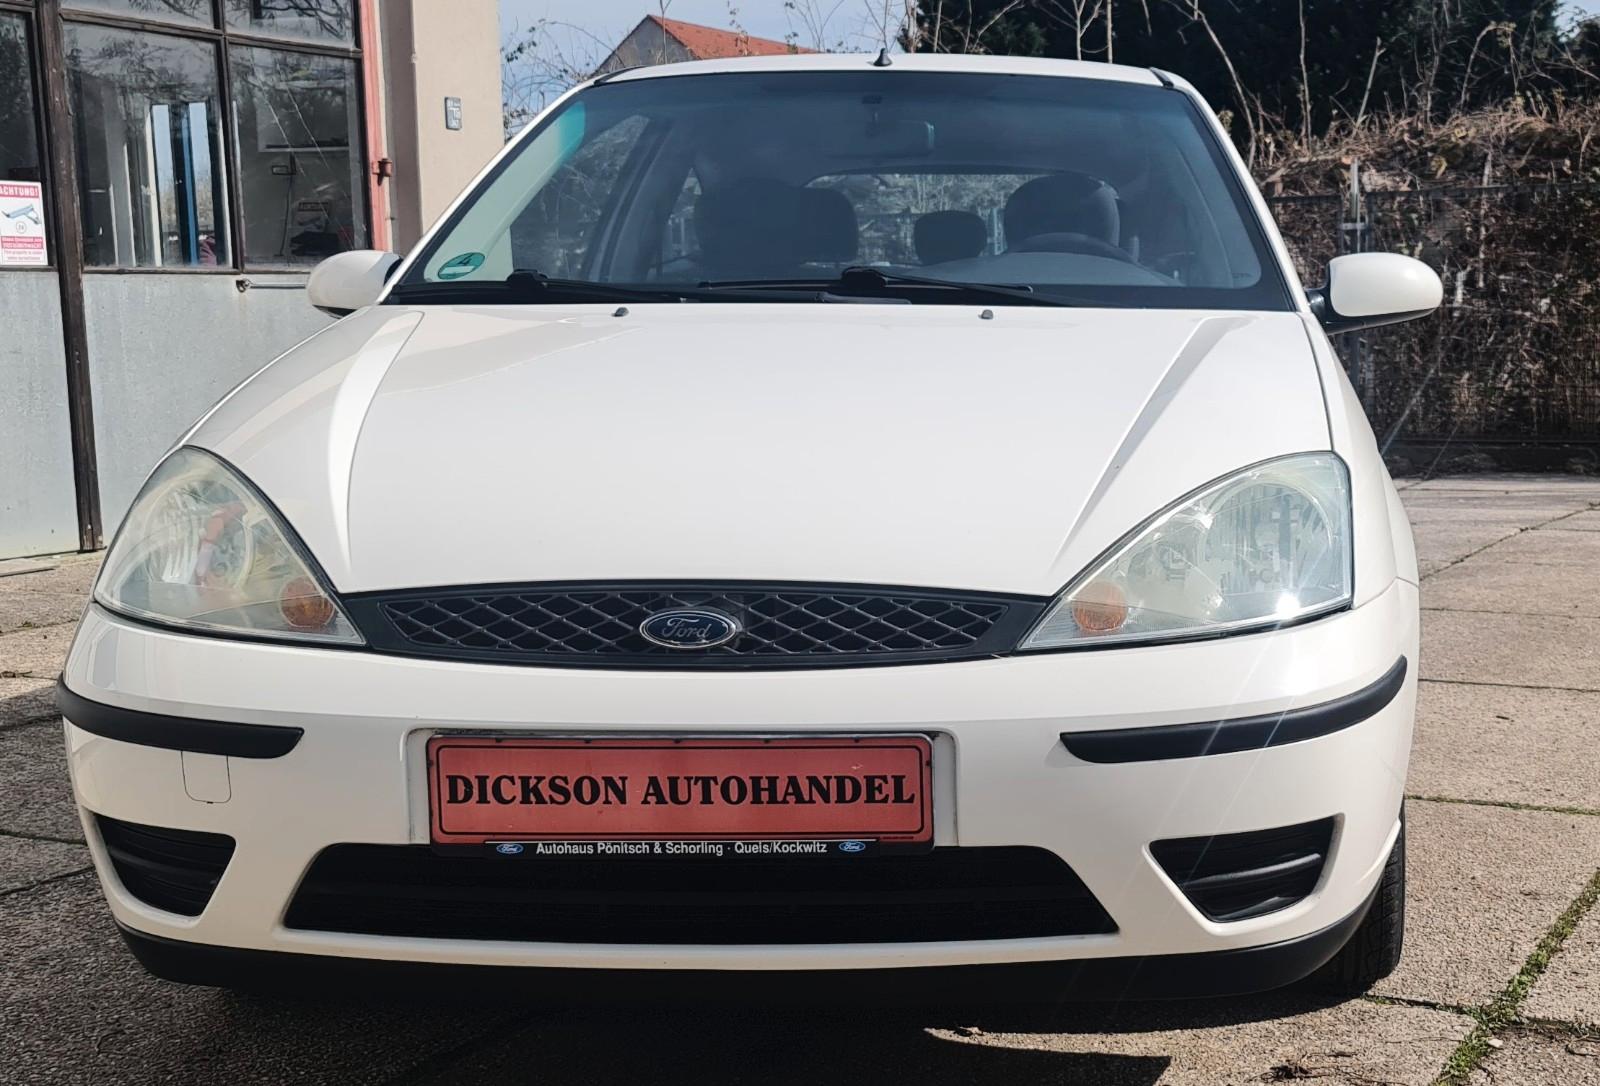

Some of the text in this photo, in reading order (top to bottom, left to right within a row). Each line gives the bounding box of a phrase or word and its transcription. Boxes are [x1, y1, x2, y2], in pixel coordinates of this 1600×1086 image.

[662, 617, 713, 639] Ford
[446, 774, 915, 806] DICKSON AUTOHANDEL
[536, 841, 594, 855] Autohaus
[597, 841, 650, 855] Pönitsch
[653, 842, 662, 854] &
[665, 841, 723, 856] Schorling
